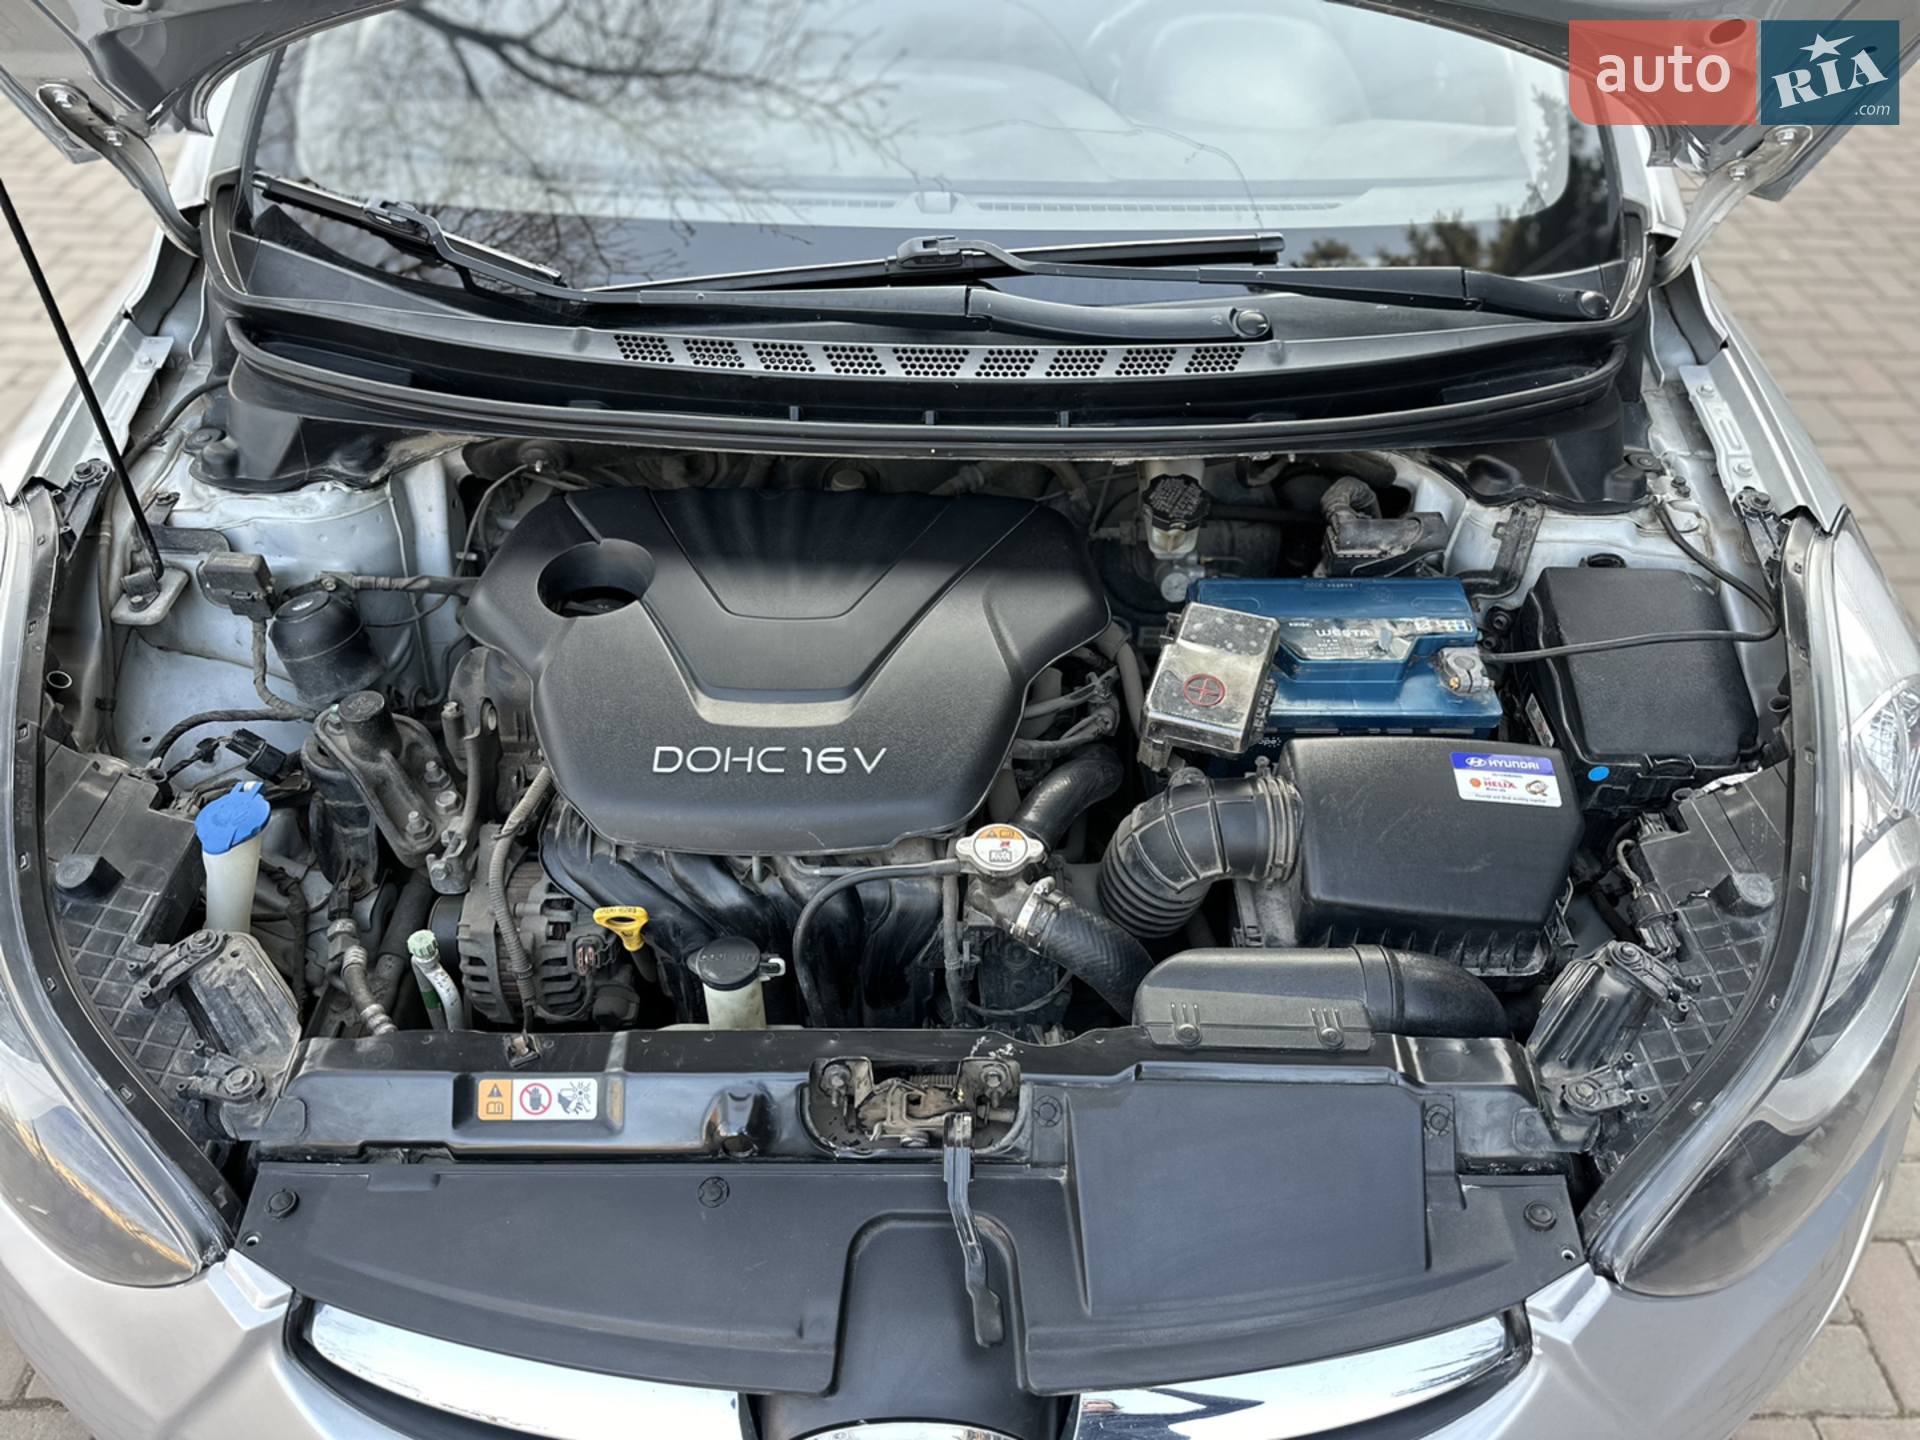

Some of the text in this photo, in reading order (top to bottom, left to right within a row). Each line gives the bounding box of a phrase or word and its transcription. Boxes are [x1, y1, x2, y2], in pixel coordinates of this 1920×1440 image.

[1315, 628, 1370, 638] WESTA
[652, 745, 787, 773] DOHC
[1488, 758, 1540, 770] HYUNDAI
[1484, 780, 1516, 789] HELIX
